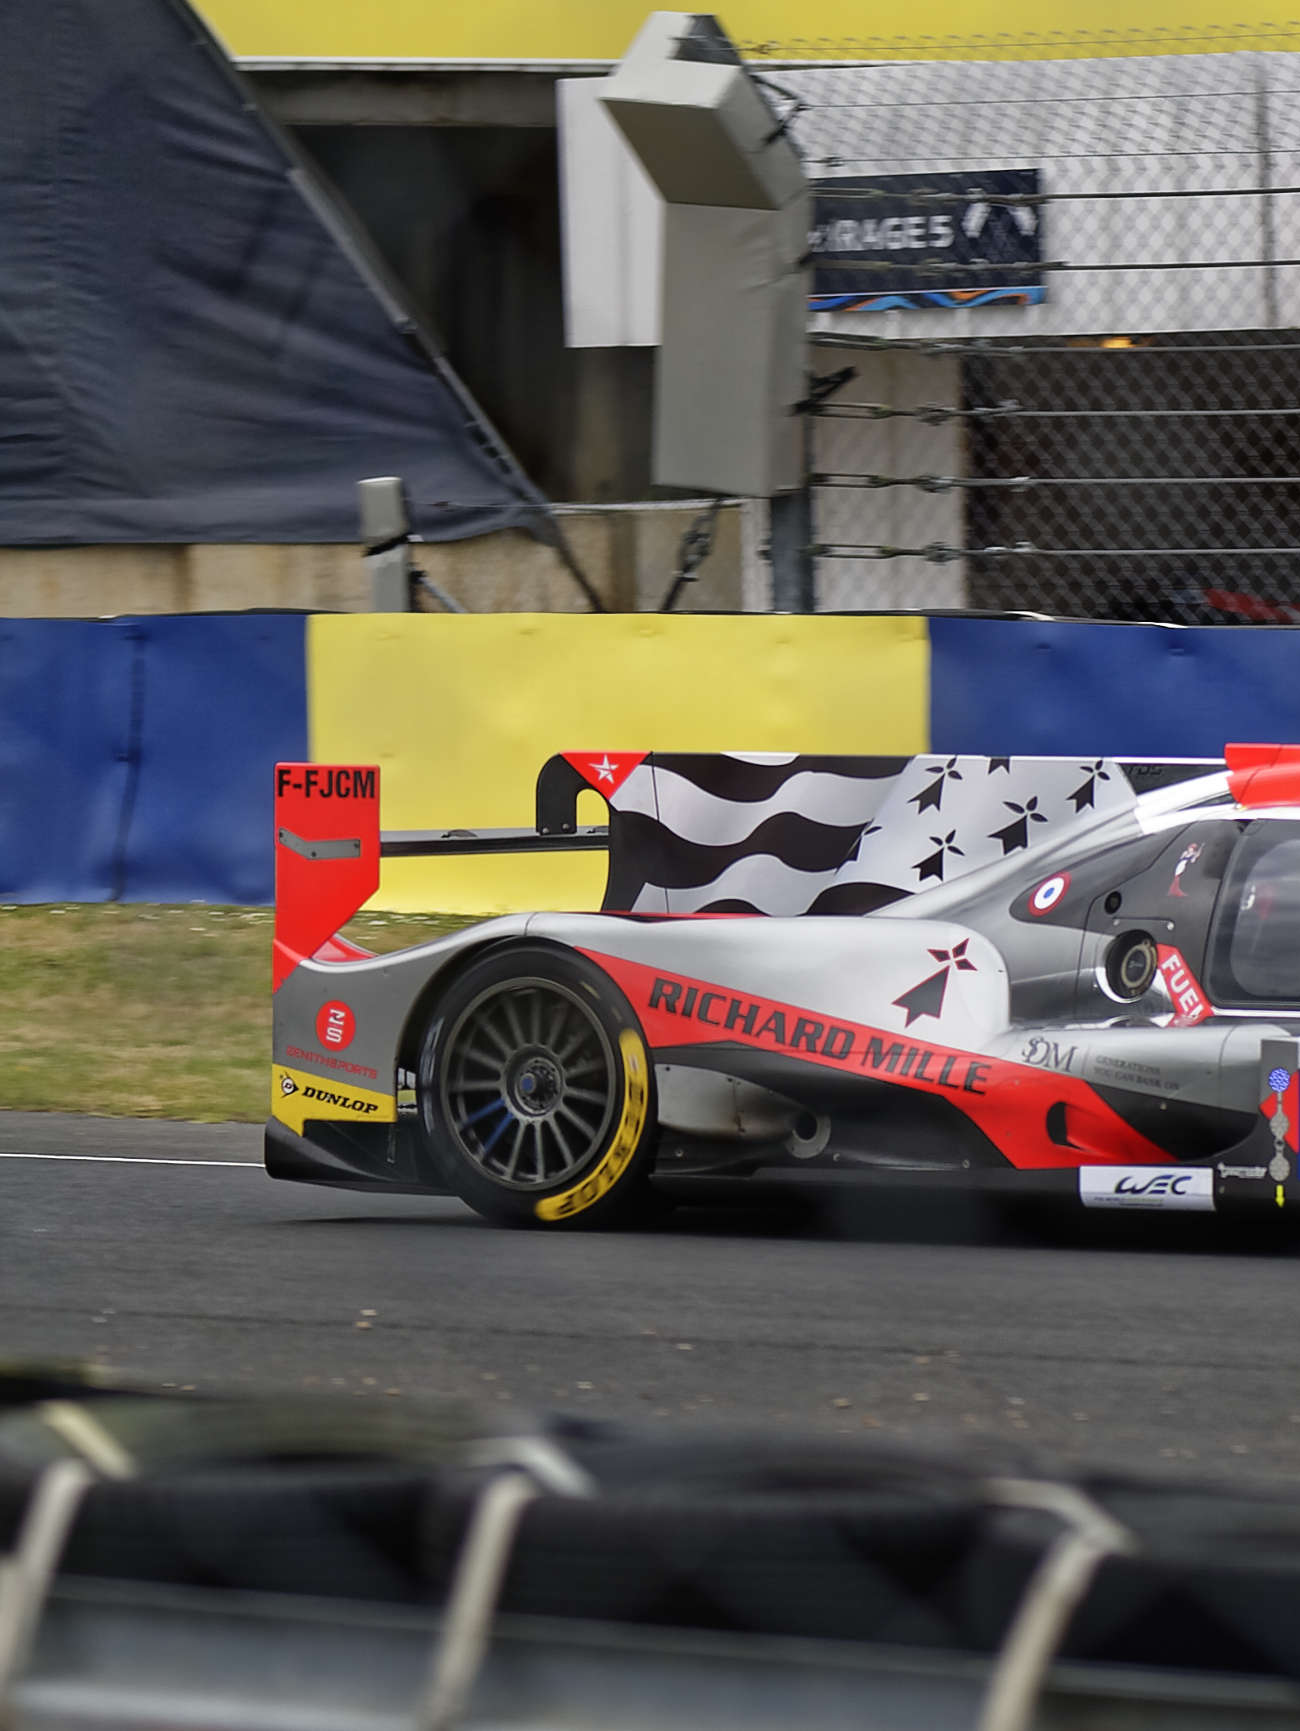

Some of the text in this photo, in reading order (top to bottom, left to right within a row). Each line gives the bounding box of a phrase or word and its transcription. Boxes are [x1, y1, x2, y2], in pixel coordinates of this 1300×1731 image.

[277, 769, 376, 798] F-FJCM
[1161, 954, 1204, 1019] FUEL
[648, 977, 993, 1096] RICHARD MILLE
[301, 1085, 379, 1115] DUNLOP
[1114, 1174, 1193, 1196] WEC
